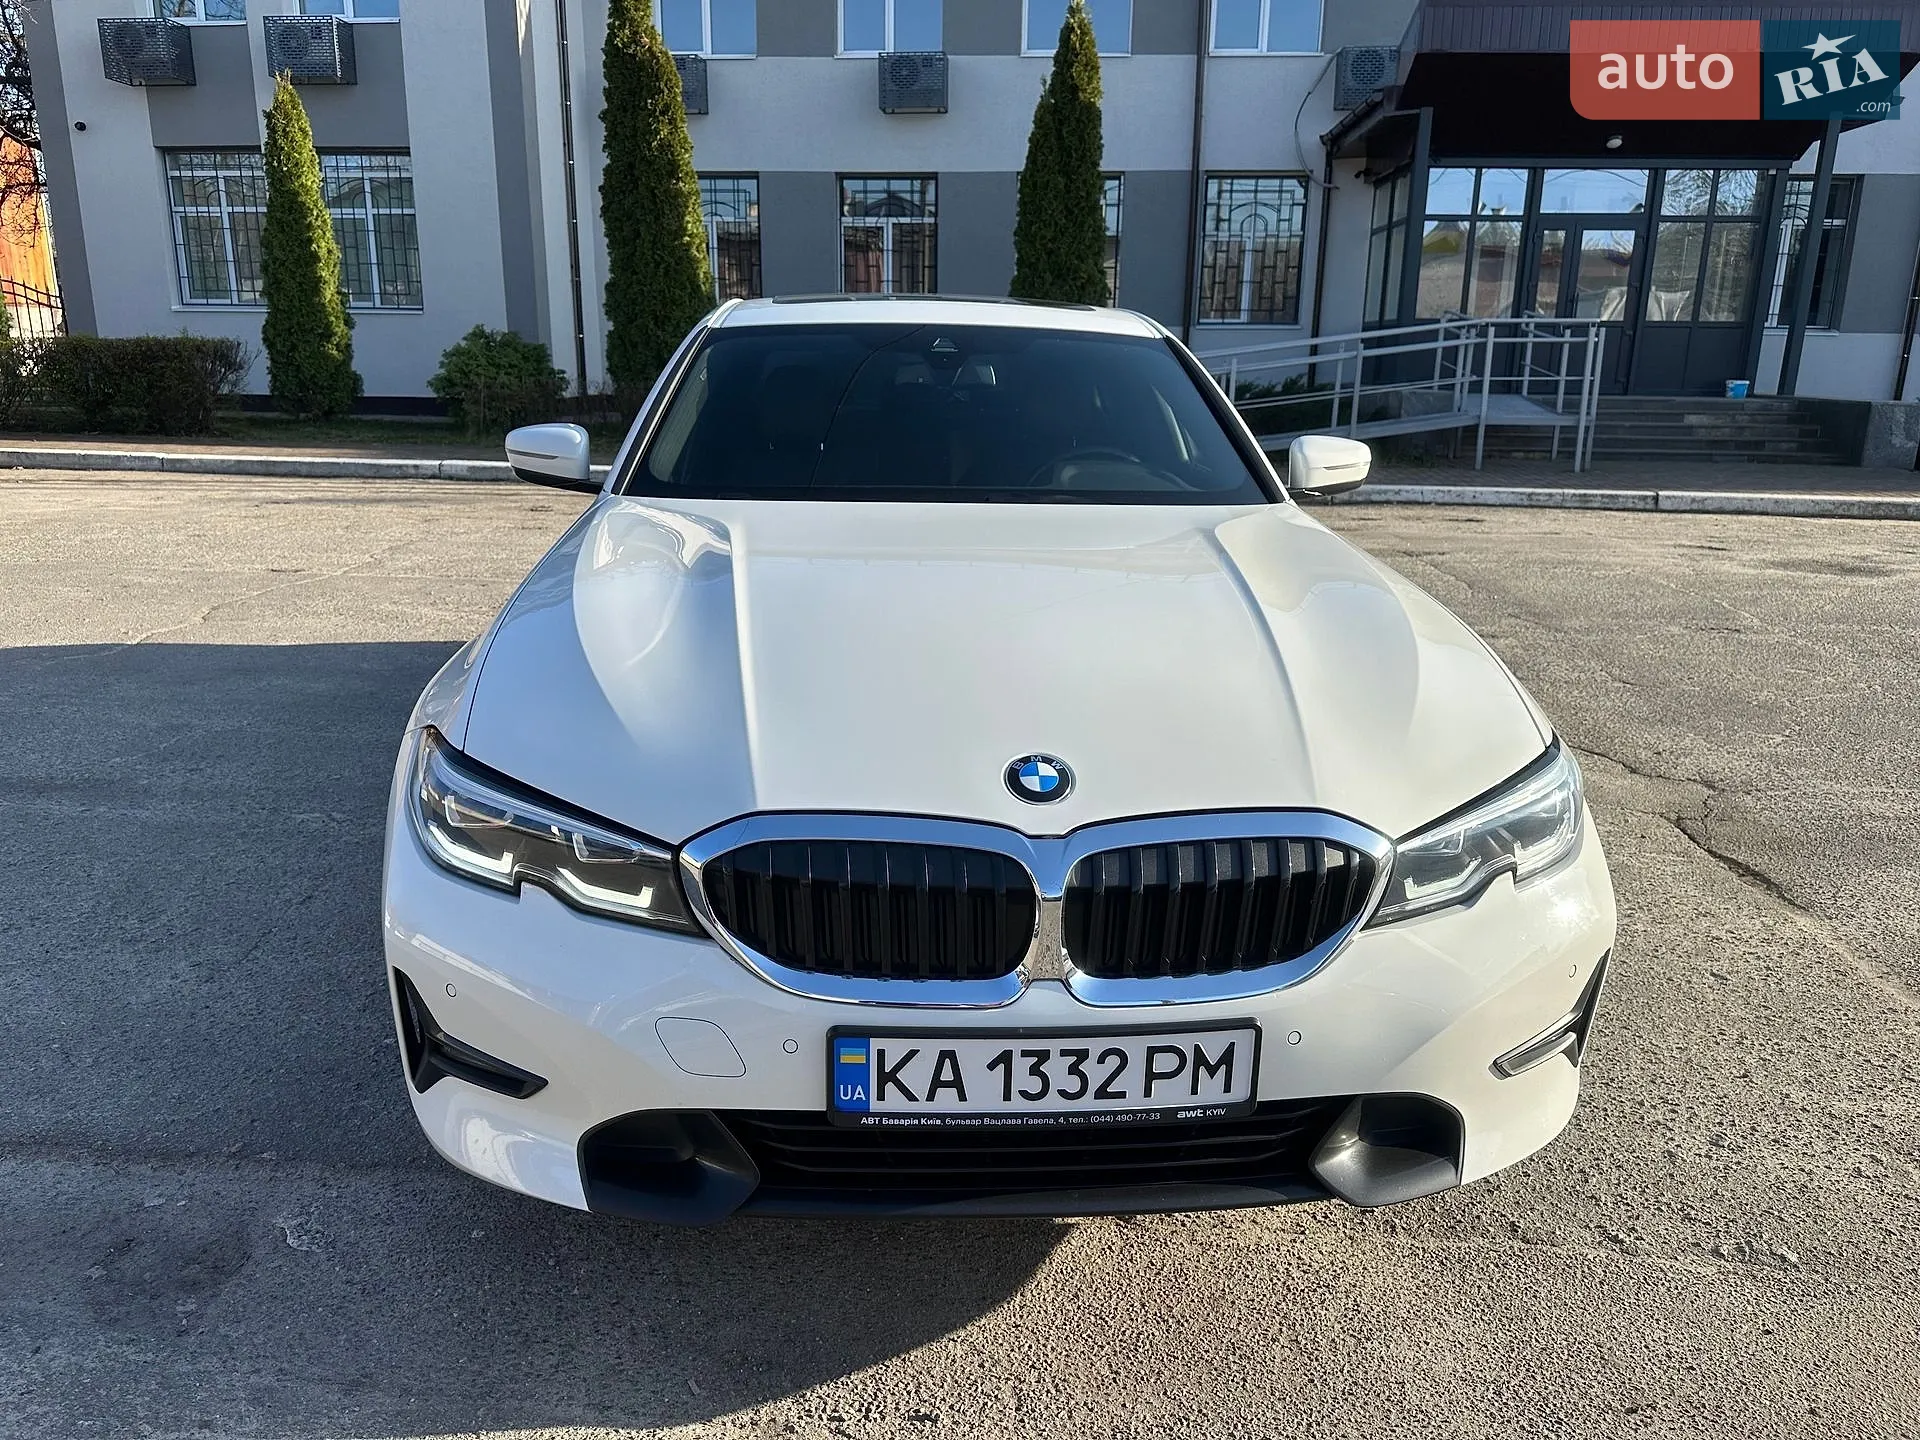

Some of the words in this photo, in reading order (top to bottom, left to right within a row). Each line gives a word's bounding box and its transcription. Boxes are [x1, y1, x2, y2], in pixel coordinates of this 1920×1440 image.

[1012, 755, 1063, 770] BMW
[876, 1048, 968, 1102] KA
[986, 1047, 1128, 1102] 1332
[1143, 1041, 1237, 1099] PM
[839, 1084, 866, 1101] UA
[882, 1116, 919, 1126] Баварія
[920, 1116, 944, 1126] Київ,
[945, 1116, 982, 1126] бульвар
[983, 1116, 1021, 1126] Вацлава
[1023, 1116, 1056, 1125] Гавела,
[1058, 1117, 1066, 1125] 4,
[1068, 1116, 1088, 1124] тел.:
[1090, 1115, 1114, 1124] (044)
[1115, 1113, 1161, 1122] 490-77-33
[1206, 1107, 1227, 1117] KYIV
